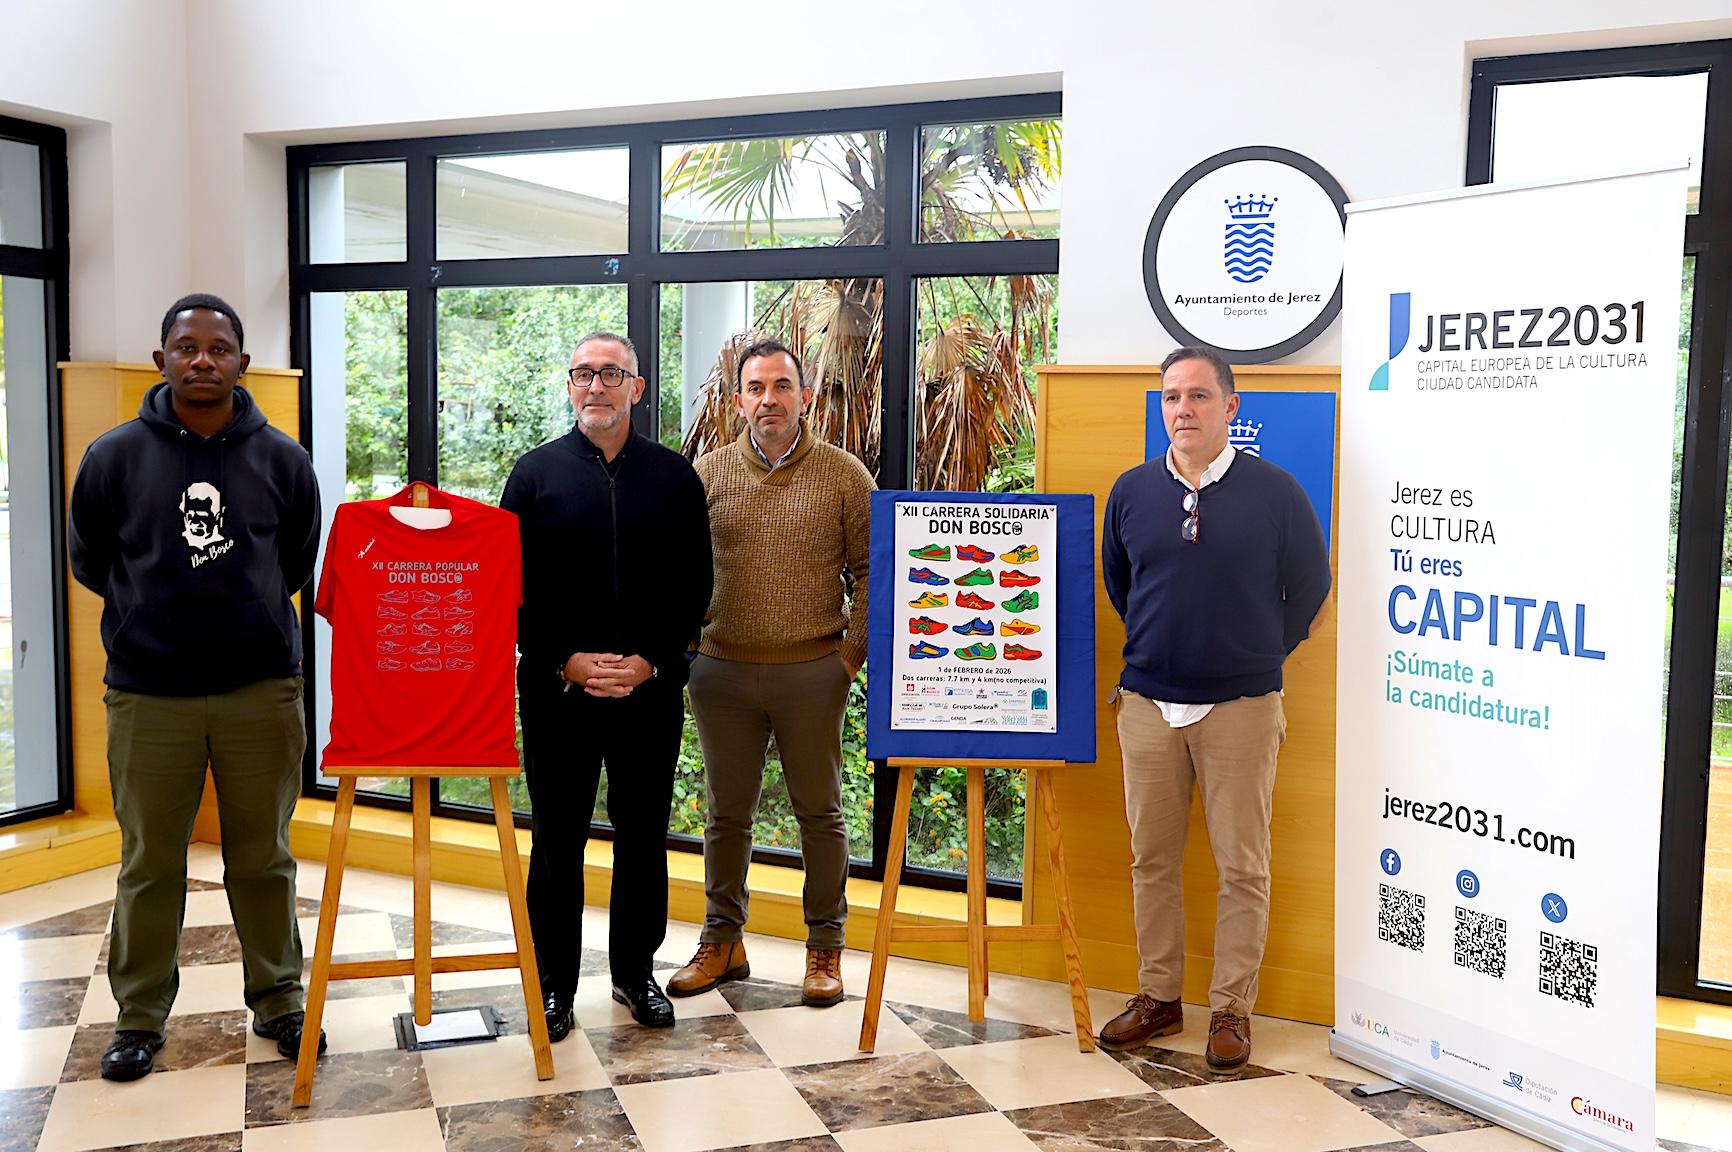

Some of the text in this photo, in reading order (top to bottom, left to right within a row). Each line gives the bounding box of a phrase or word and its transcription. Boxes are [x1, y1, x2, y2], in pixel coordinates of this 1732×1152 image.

[1174, 292, 1321, 307] Ayuntamiento de Jerez
[1223, 307, 1268, 318] Deportes
[1418, 300, 1645, 353] JEREZ2031
[1417, 353, 1648, 374] CAPITAL EUROPEA DE LA CULTURA
[1417, 375, 1538, 391] CIUDAD CANDIDATA
[1391, 481, 1473, 508] Jerez es
[902, 505, 1049, 520] XII CARRERA SOLIDARIA
[929, 519, 963, 535] DON
[1390, 514, 1496, 545] CULTURA
[387, 561, 432, 571] CARRERA
[435, 562, 479, 571] POPULAR
[1390, 548, 1463, 577] Tú eres
[388, 572, 416, 584] DON
[1388, 584, 1606, 660] CAPITAL
[995, 667, 1012, 675] 2026
[1387, 650, 1494, 687] ¡Súmate a
[1006, 677, 1047, 685] competitiva)
[952, 703, 973, 711] Grupo
[1386, 679, 1550, 730] la candidatura!
[1382, 788, 1575, 860] jerez2031.com
[1525, 1077, 1558, 1096] Diputación
[1571, 1096, 1634, 1132] Cámara
